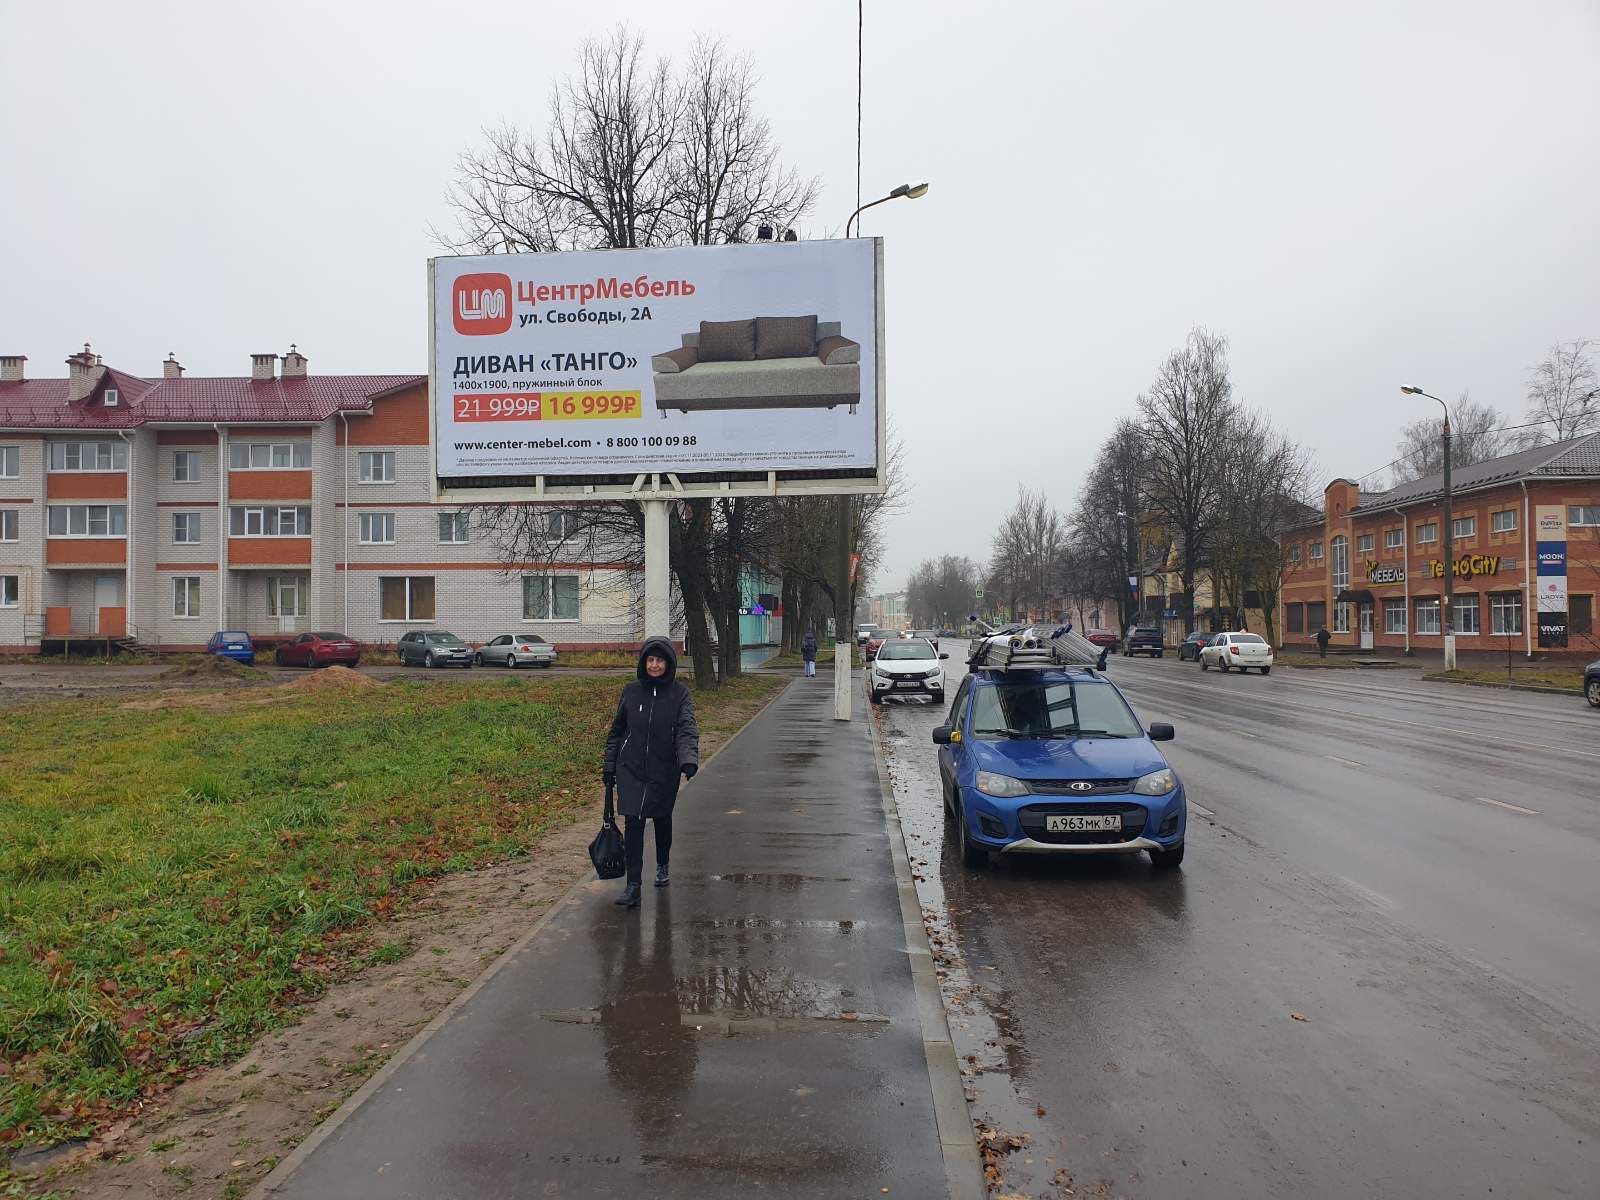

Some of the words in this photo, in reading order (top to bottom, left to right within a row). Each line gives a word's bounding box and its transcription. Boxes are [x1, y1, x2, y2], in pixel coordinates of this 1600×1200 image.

[517, 275, 696, 306] ЦентрМебель
[519, 312, 543, 328] ул.
[546, 308, 626, 324] Свободы,
[631, 306, 652, 321] 2А
[453, 354, 534, 379] ДИВАН
[540, 351, 638, 372] «ТАНГО»
[512, 378, 575, 391] пружинный
[577, 378, 603, 387] блок
[458, 399, 481, 418] 21
[550, 396, 576, 416] 16
[454, 438, 591, 451] www.center-mebel.com
[606, 437, 614, 448] 8
[616, 437, 639, 448] 800
[643, 436, 663, 447] 100
[665, 436, 680, 447] 09
[683, 435, 697, 446] 88
[1371, 568, 1405, 583] МЕБЕЛЬ
[1429, 554, 1500, 578] ТеноCity
[1104, 816, 1117, 825] 67
